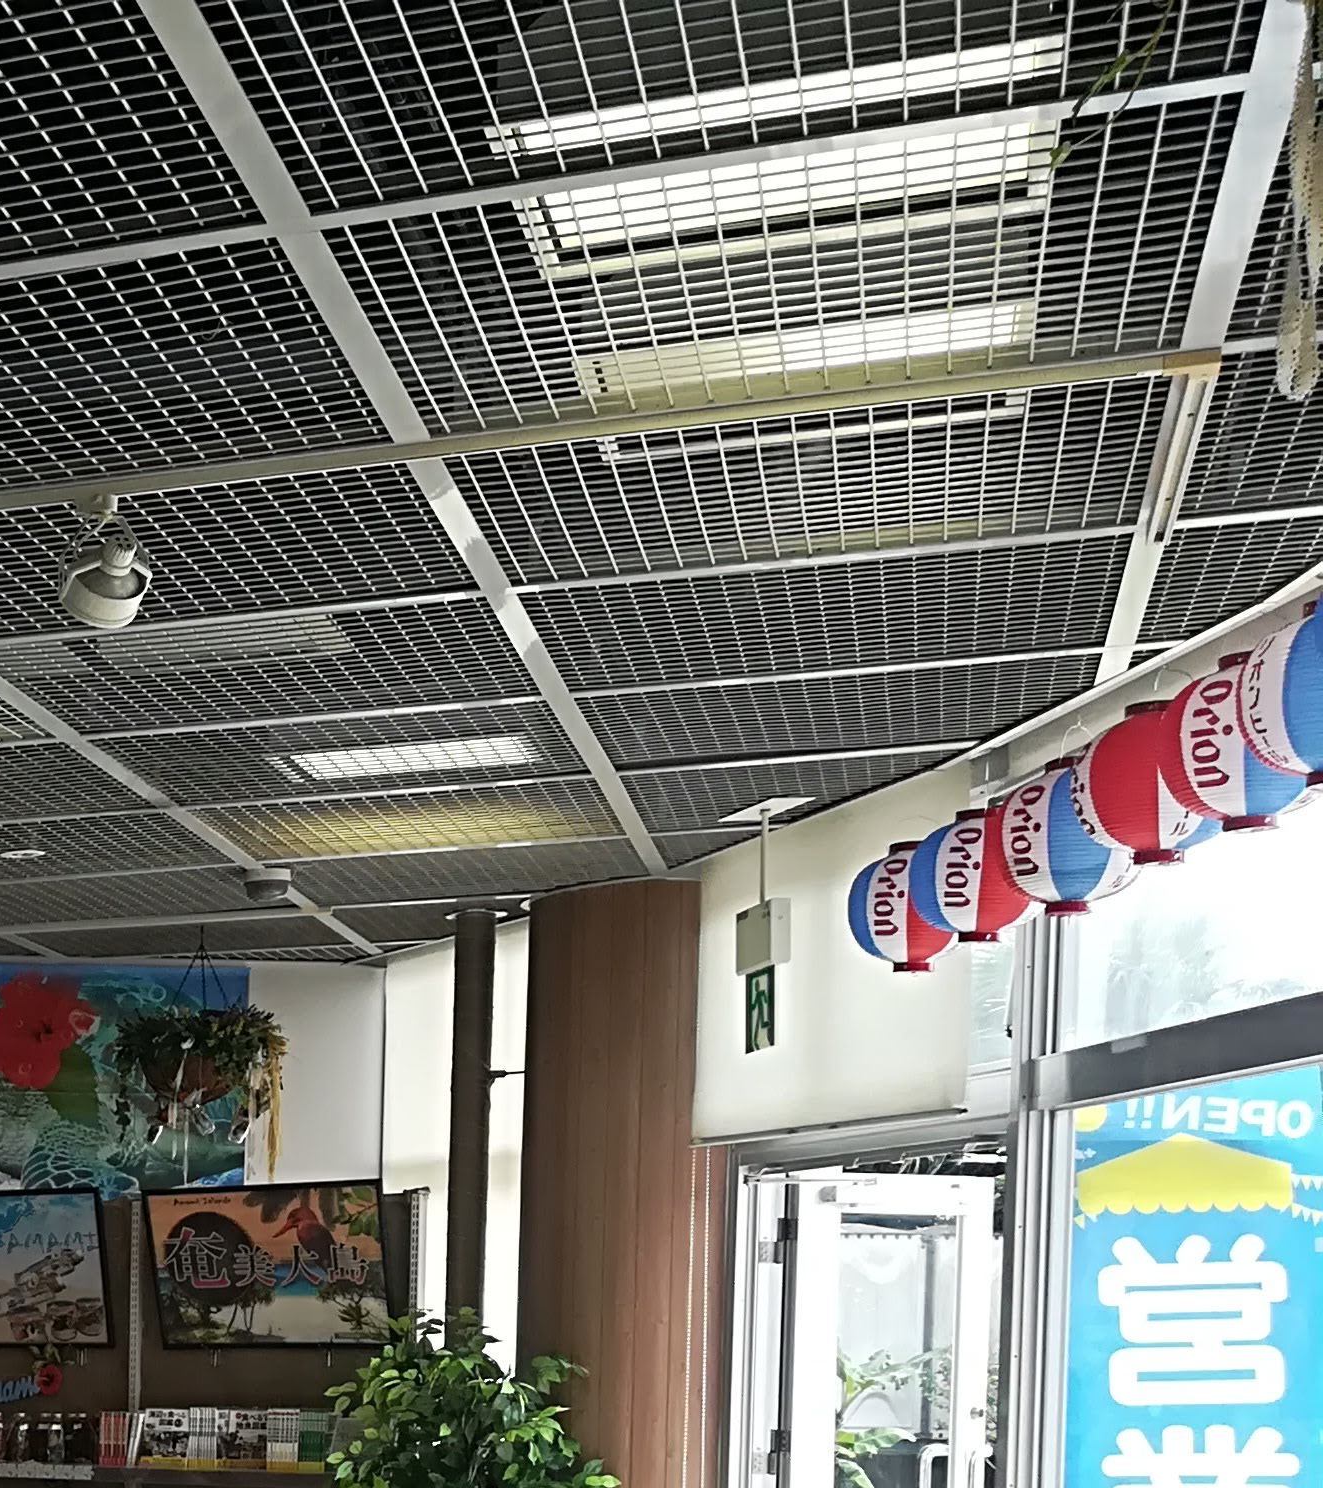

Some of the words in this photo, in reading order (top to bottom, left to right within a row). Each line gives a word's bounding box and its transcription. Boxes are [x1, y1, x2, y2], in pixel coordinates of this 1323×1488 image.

[1190, 679, 1233, 788] Orion
[943, 826, 983, 908] Orion
[1010, 784, 1047, 877] Orion
[873, 858, 908, 937] Orion
[163, 1226, 370, 1289] 奄美大島
